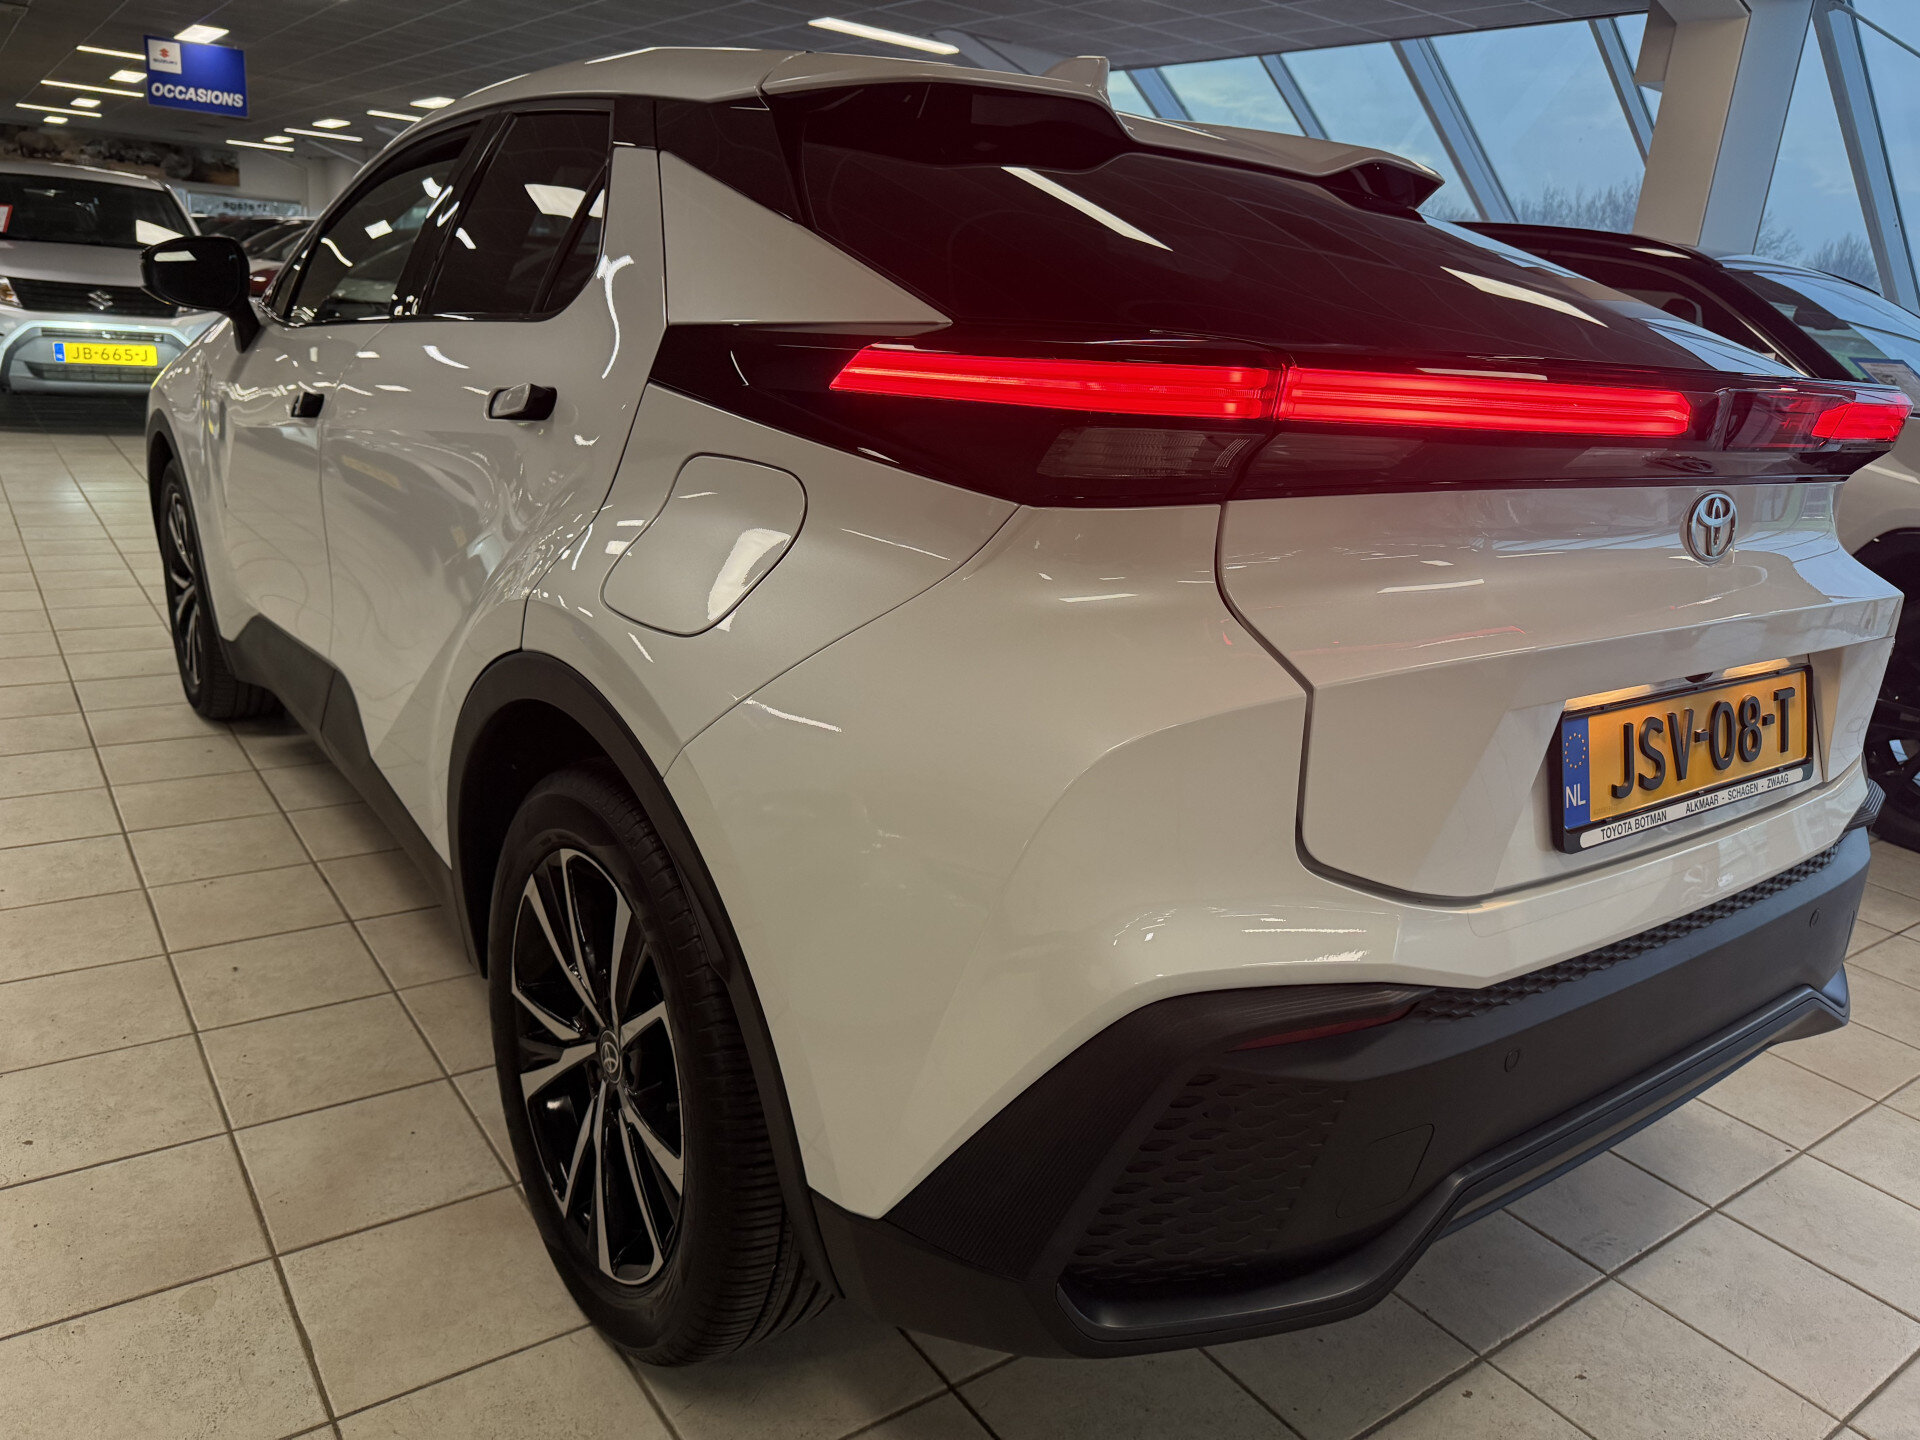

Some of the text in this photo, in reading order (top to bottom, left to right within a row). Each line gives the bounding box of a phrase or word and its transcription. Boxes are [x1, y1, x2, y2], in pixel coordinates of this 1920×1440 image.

[151, 82, 244, 108] OCCASIONS
[73, 346, 148, 362] JB-665-J
[1611, 687, 1796, 799] JSV-08-T
[1565, 783, 1586, 808] NL
[1601, 824, 1632, 840] TOYOTA
[1635, 810, 1667, 830] BOTMAN
[1686, 794, 1719, 814] ALKMAAR
[1727, 782, 1759, 801] SCHAGEN
[1767, 773, 1789, 789] ZWAAG
